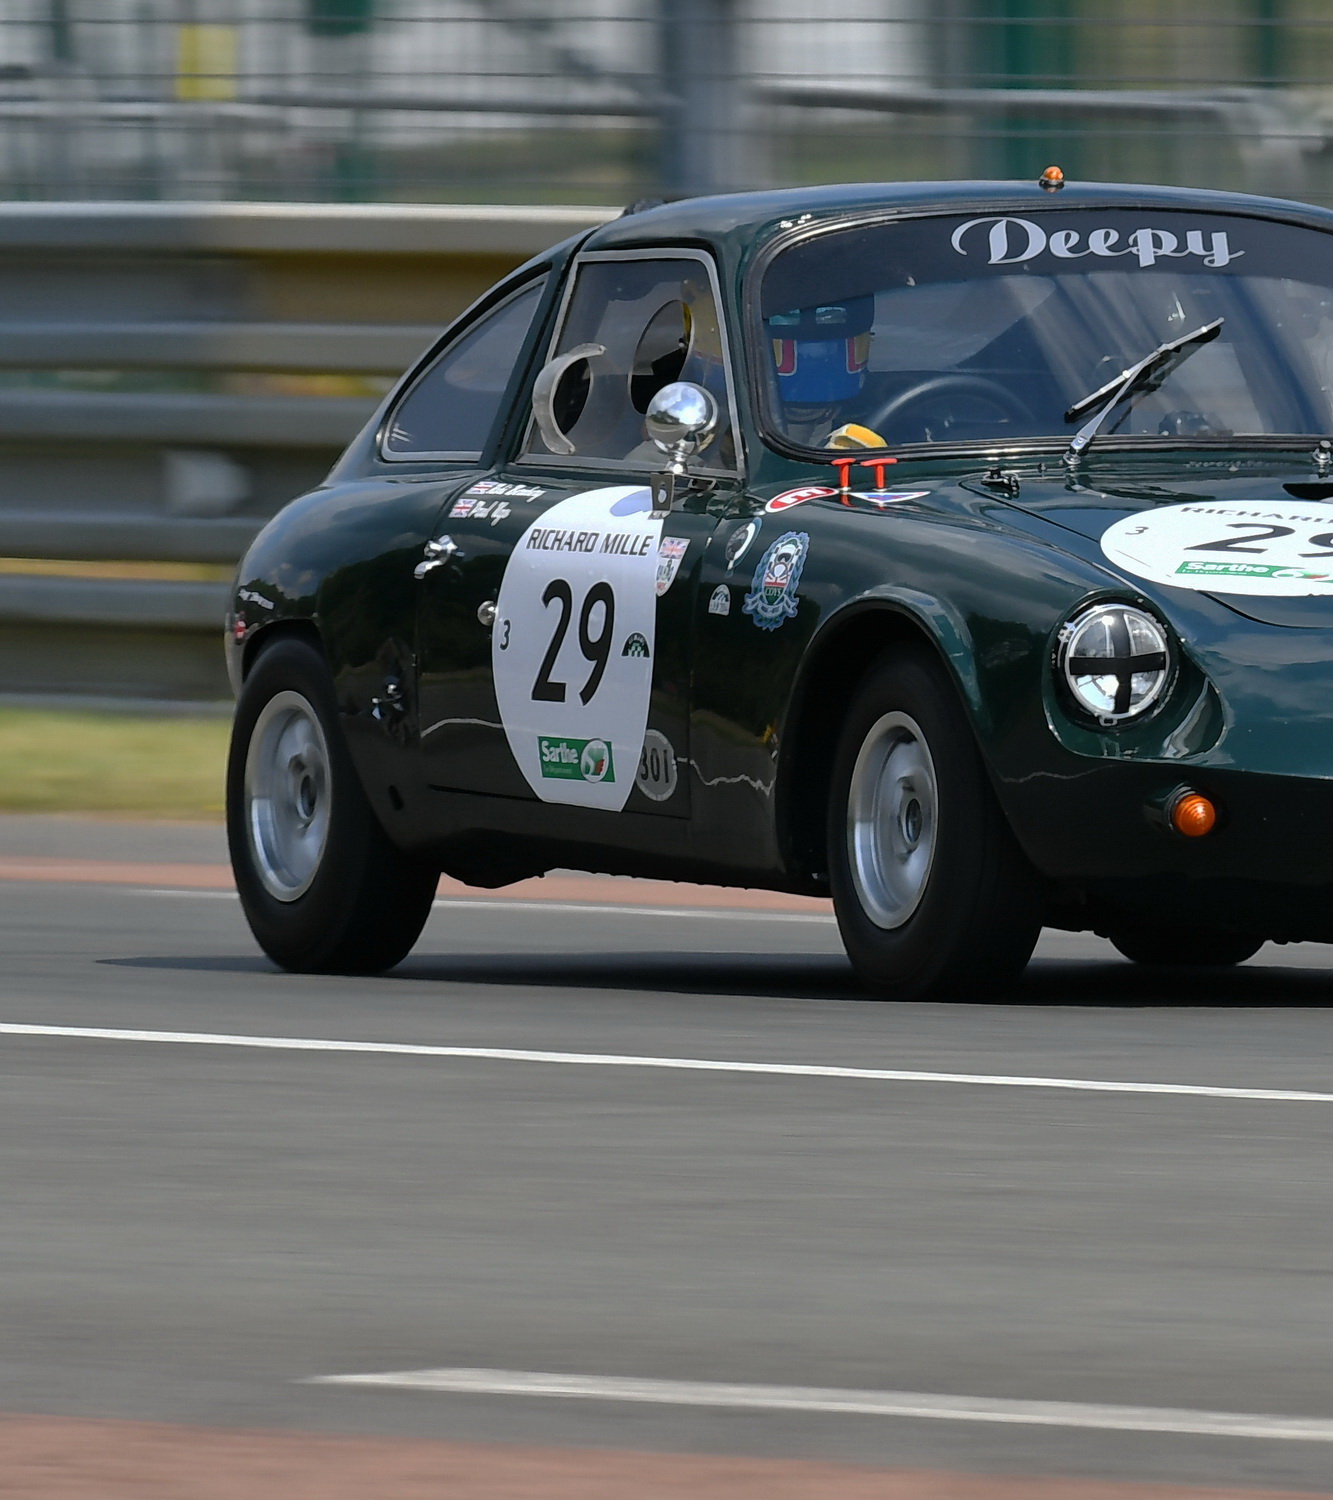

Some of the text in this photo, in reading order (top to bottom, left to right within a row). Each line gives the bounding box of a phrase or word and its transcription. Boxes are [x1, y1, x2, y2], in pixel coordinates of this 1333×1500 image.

[951, 216, 1245, 268] Deepy
[526, 528, 654, 556] RICHARD MILLE
[1124, 525, 1150, 536] 3
[1185, 562, 1269, 573] Sarthe
[500, 620, 511, 650] 3
[531, 578, 615, 706] 29
[541, 740, 579, 764] Sarthe
[640, 745, 669, 784] 301
